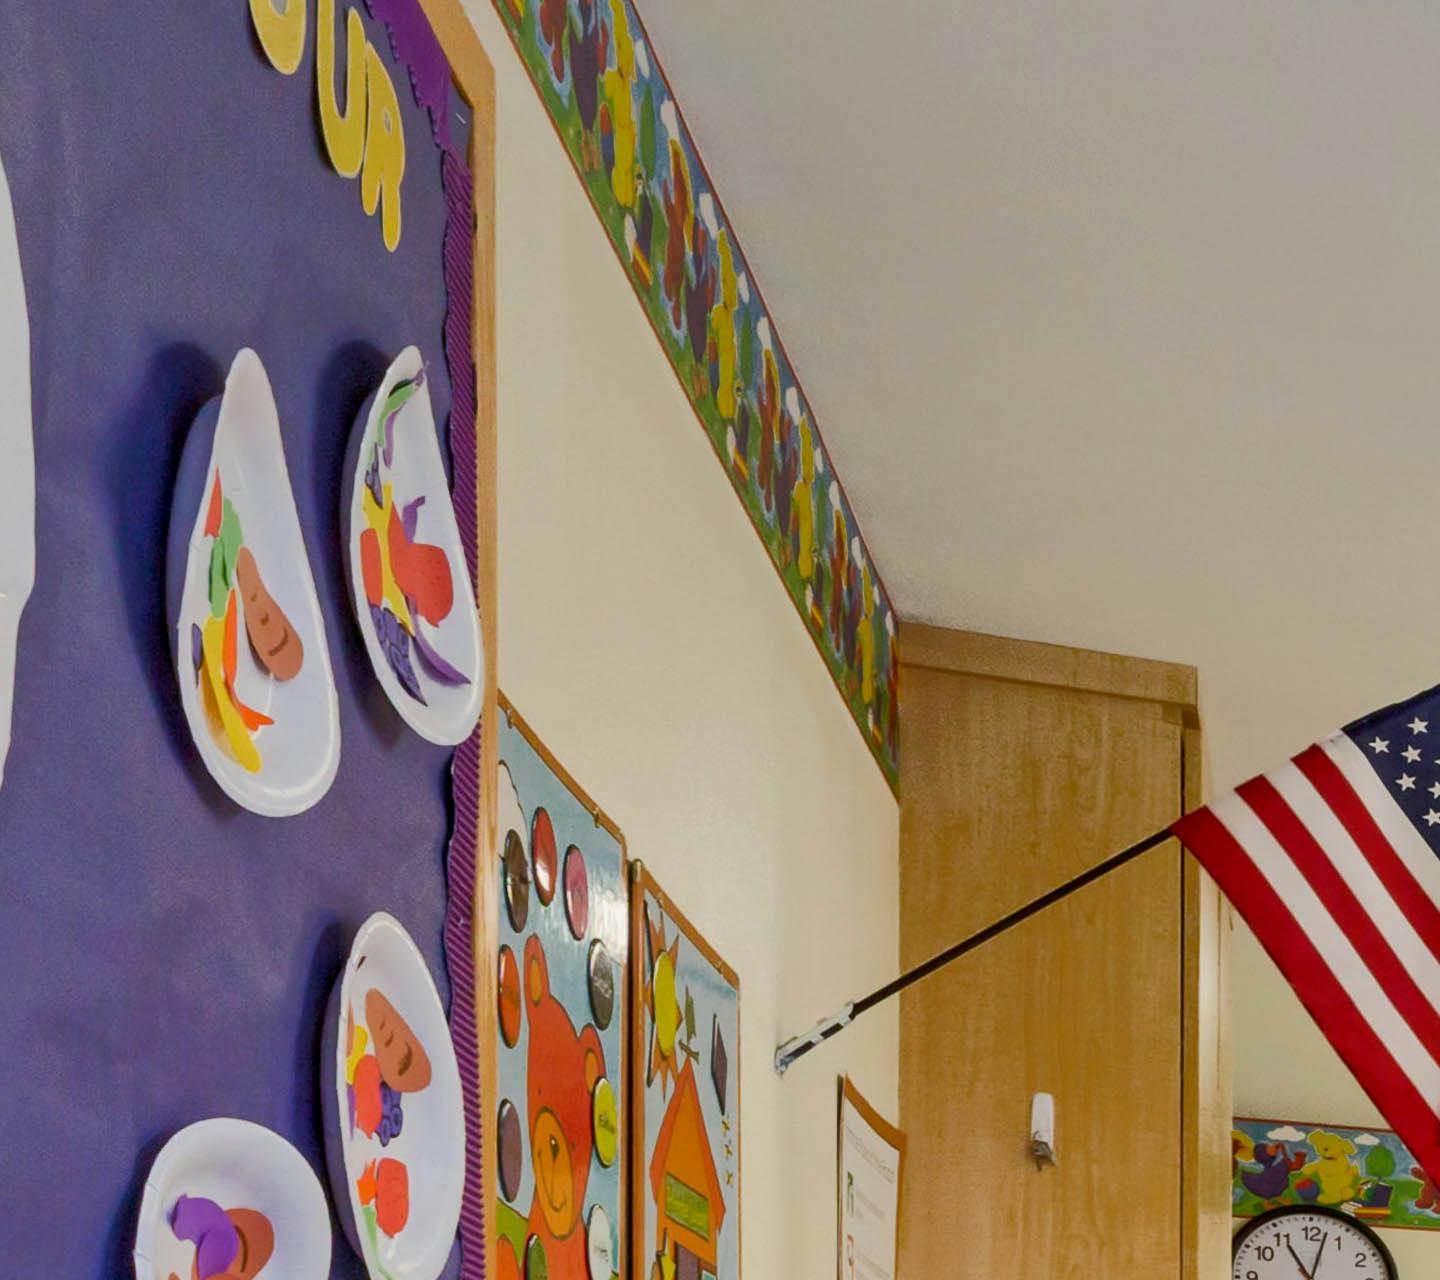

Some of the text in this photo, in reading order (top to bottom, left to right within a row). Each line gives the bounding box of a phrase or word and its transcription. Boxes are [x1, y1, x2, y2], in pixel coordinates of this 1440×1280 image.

[1273, 1232, 1291, 1247] 11
[1302, 1226, 1321, 1242] 12
[1335, 1236, 1342, 1251] 1
[1254, 1246, 1274, 1261] 10
[1355, 1253, 1367, 1268] 2
